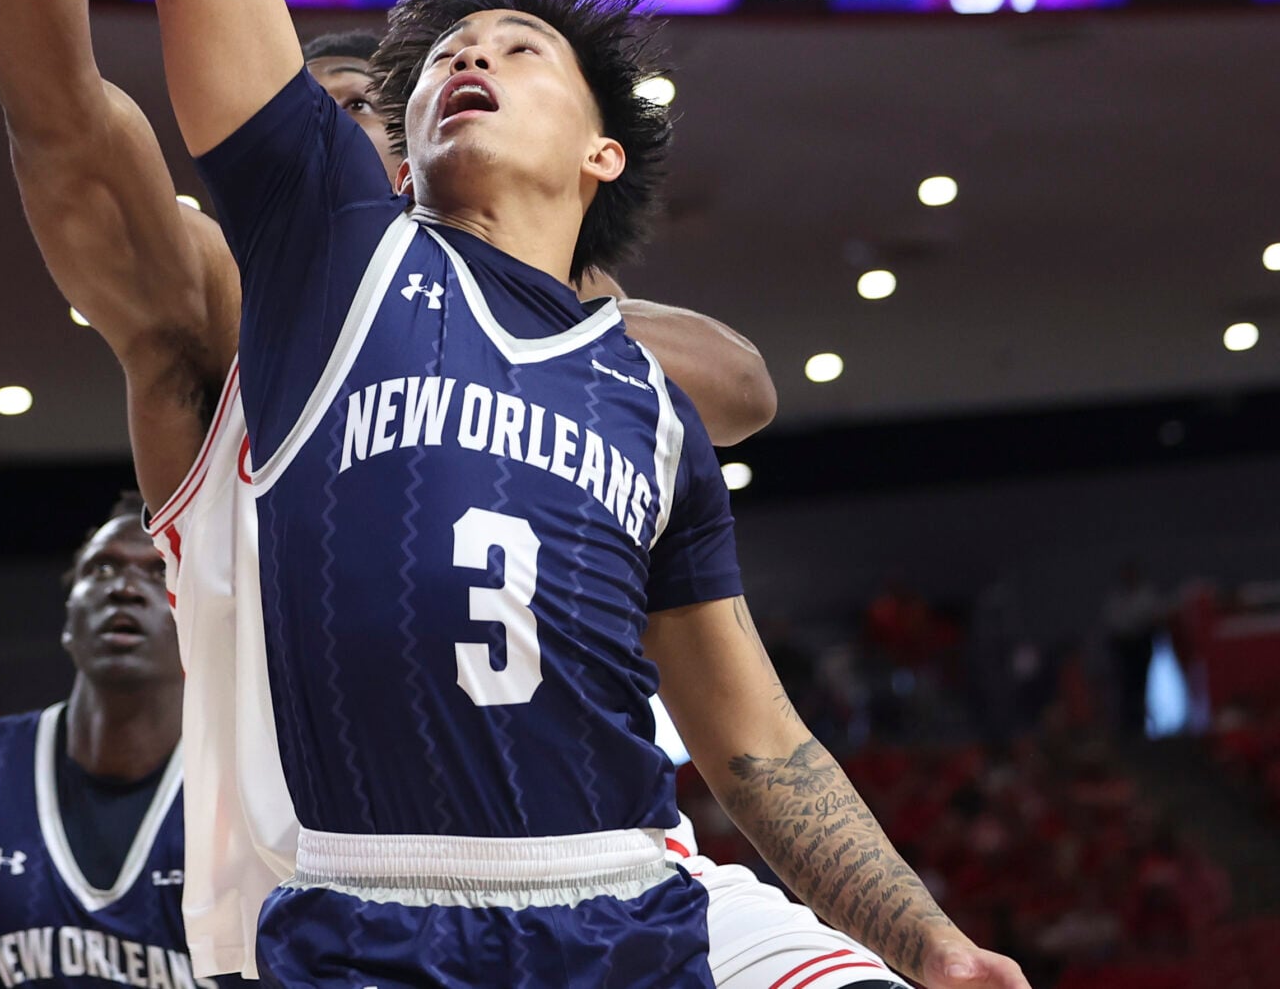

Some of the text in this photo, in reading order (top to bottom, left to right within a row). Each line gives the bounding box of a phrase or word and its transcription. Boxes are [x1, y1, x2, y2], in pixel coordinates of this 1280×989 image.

[338, 376, 653, 547] NEW ORLEANS
[452, 507, 544, 706] 3
[815, 791, 859, 823] Lord
[59, 926, 220, 989] ORLEAN
